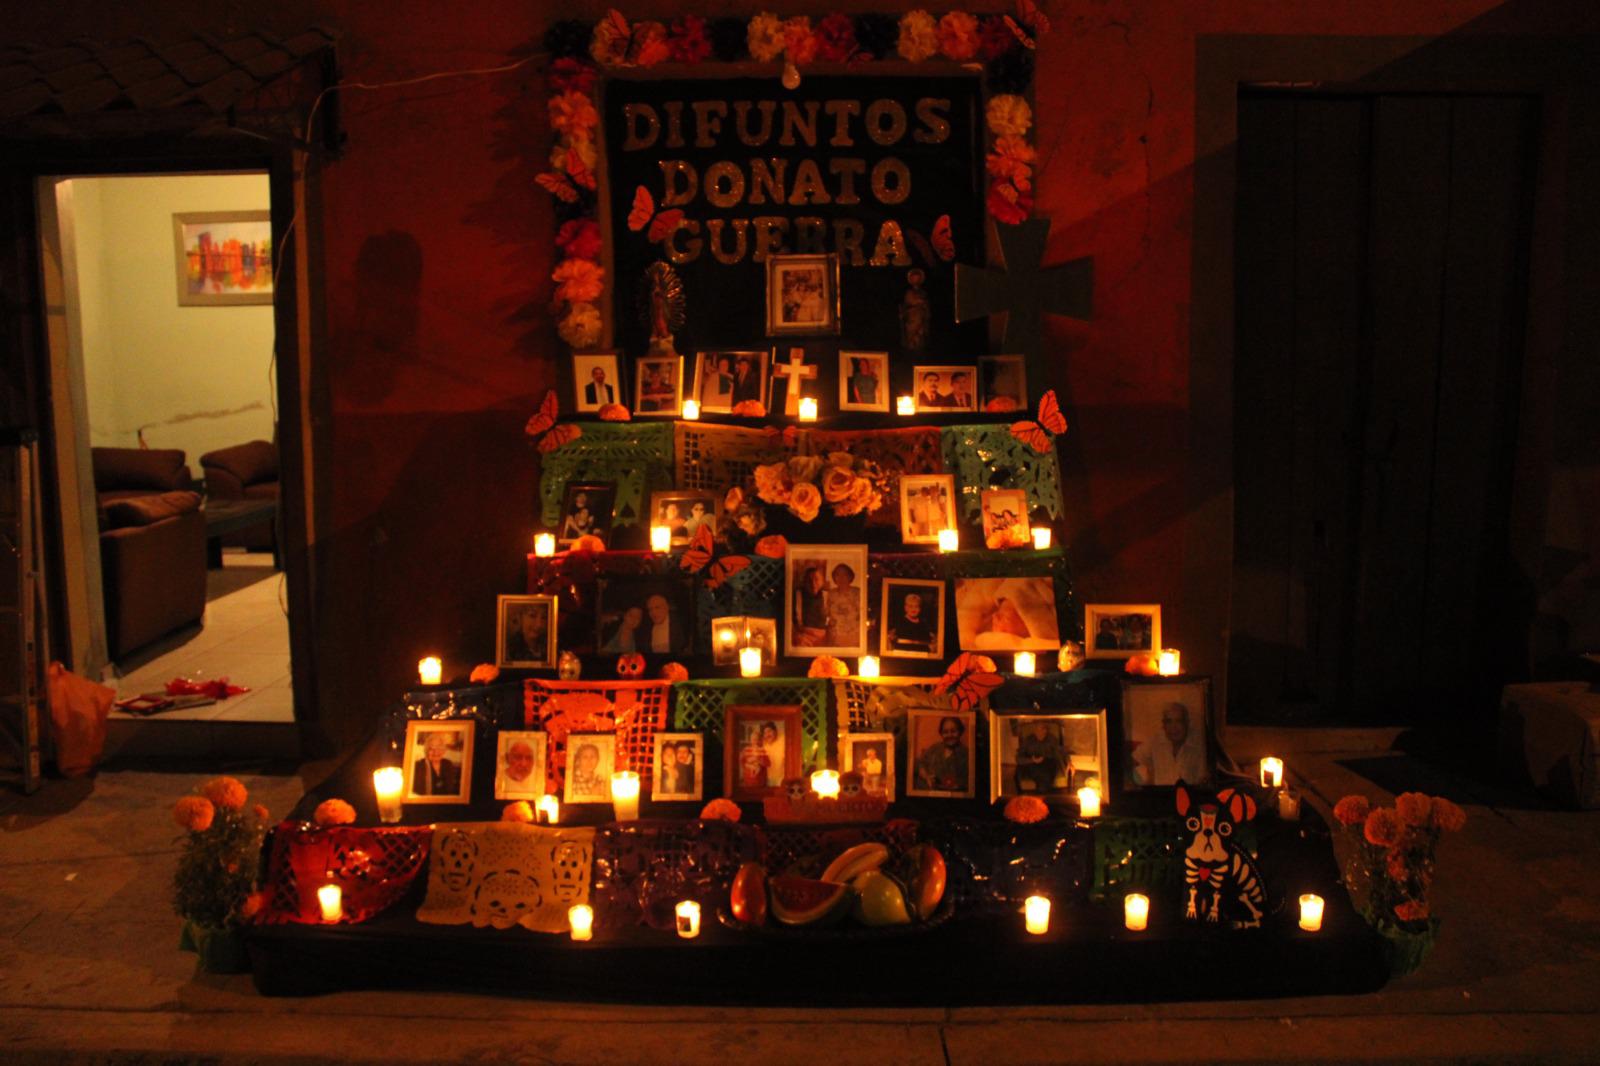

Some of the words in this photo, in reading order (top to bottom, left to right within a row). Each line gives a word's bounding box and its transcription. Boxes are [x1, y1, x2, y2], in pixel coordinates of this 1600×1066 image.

[623, 98, 951, 151] DIFUNTOS
[658, 156, 912, 208] DONATO
[663, 215, 912, 267] GUERRA
